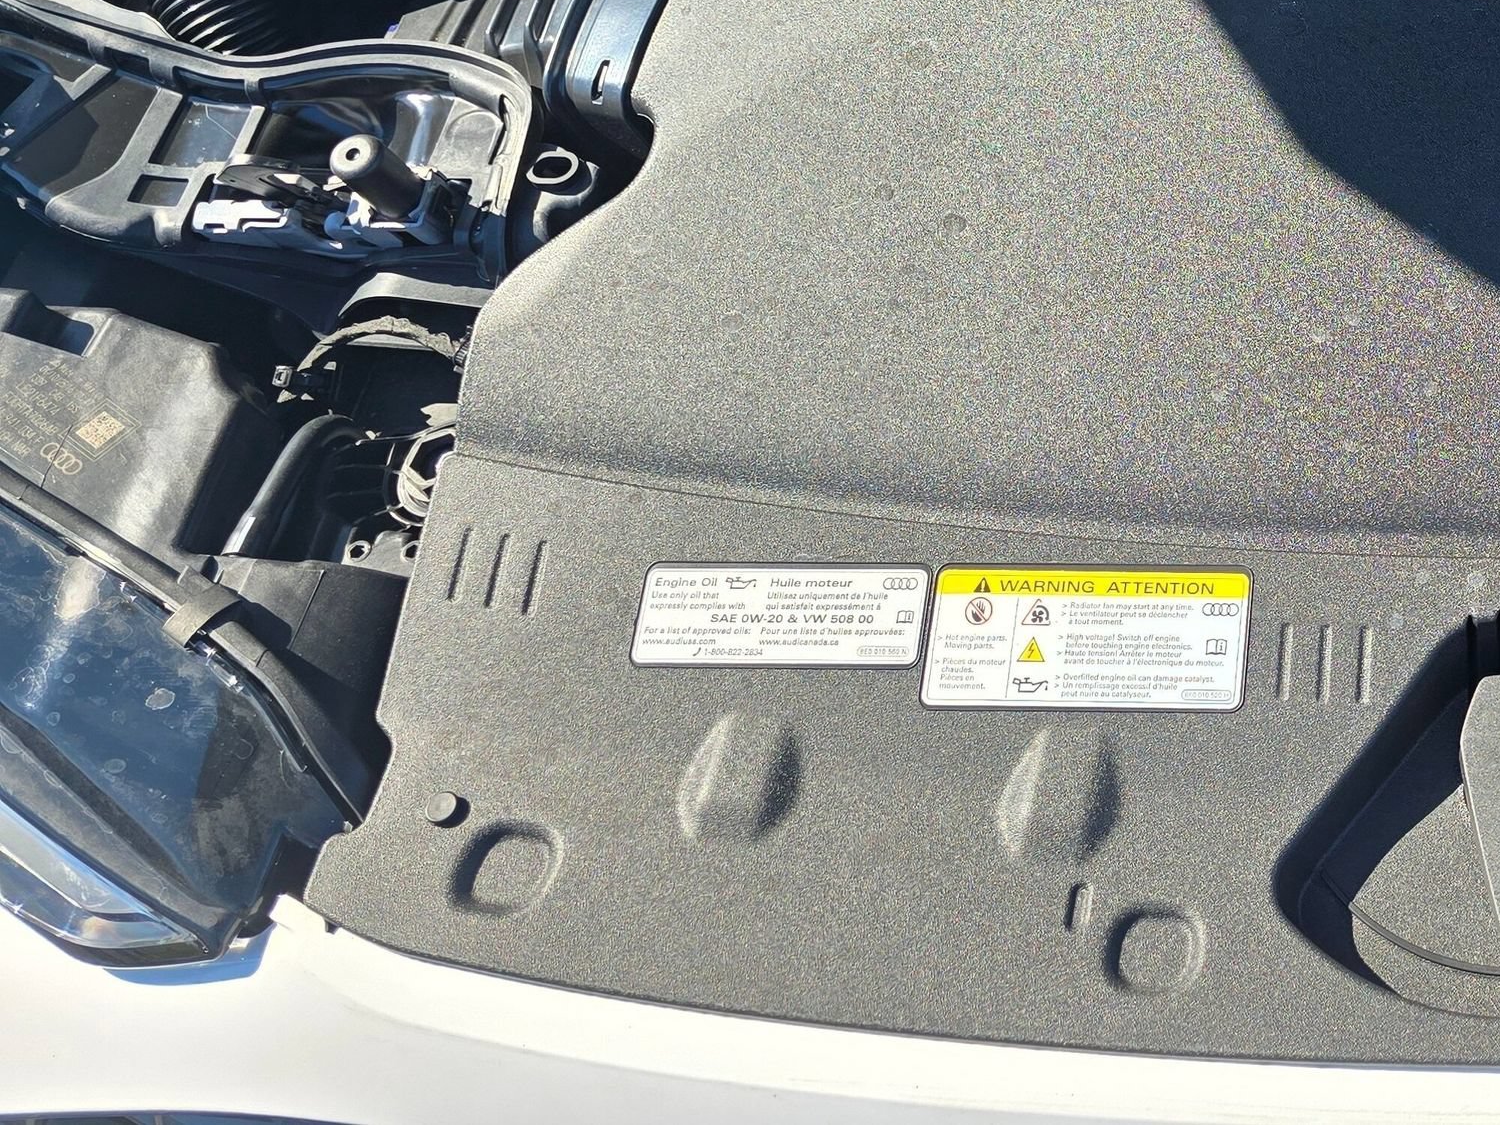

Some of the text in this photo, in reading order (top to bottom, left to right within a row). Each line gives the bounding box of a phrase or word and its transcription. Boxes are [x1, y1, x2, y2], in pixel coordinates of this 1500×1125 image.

[655, 577, 718, 588] Engine Oil
[770, 578, 853, 588] Huile moteur
[999, 580, 1215, 594] WARNING ATTENTION
[652, 591, 719, 601] Use only oil that
[767, 592, 797, 600] Utilisez
[799, 592, 849, 602] uniquement
[851, 592, 861, 600] de
[650, 602, 746, 611] expressly complies with
[765, 603, 779, 612] qui
[781, 603, 814, 611] satisfait
[1103, 602, 1114, 610] fan
[1160, 604, 1174, 612] any
[710, 614, 874, 624] SAE 0W-20 & VW 508 00
[1120, 611, 1137, 619] peut
[644, 627, 658, 635] For
[667, 627, 680, 635] list
[681, 627, 691, 635] of
[692, 627, 731, 636] approved
[760, 627, 780, 635] Pour
[800, 627, 818, 635] liste
[759, 638, 839, 646] www.audicanada.ca
[960, 634, 985, 642] engine
[1066, 634, 1180, 643] High voltage! Switch off engine
[944, 642, 972, 650] Moving
[1091, 642, 1123, 650] touching
[1124, 643, 1149, 651] engine
[1101, 675, 1125, 683] engine
[1153, 675, 1182, 683] damage
[1185, 675, 1214, 684] catalyst.
[1075, 682, 1119, 690] remplissage
[1112, 691, 1151, 699] catalyseur.
